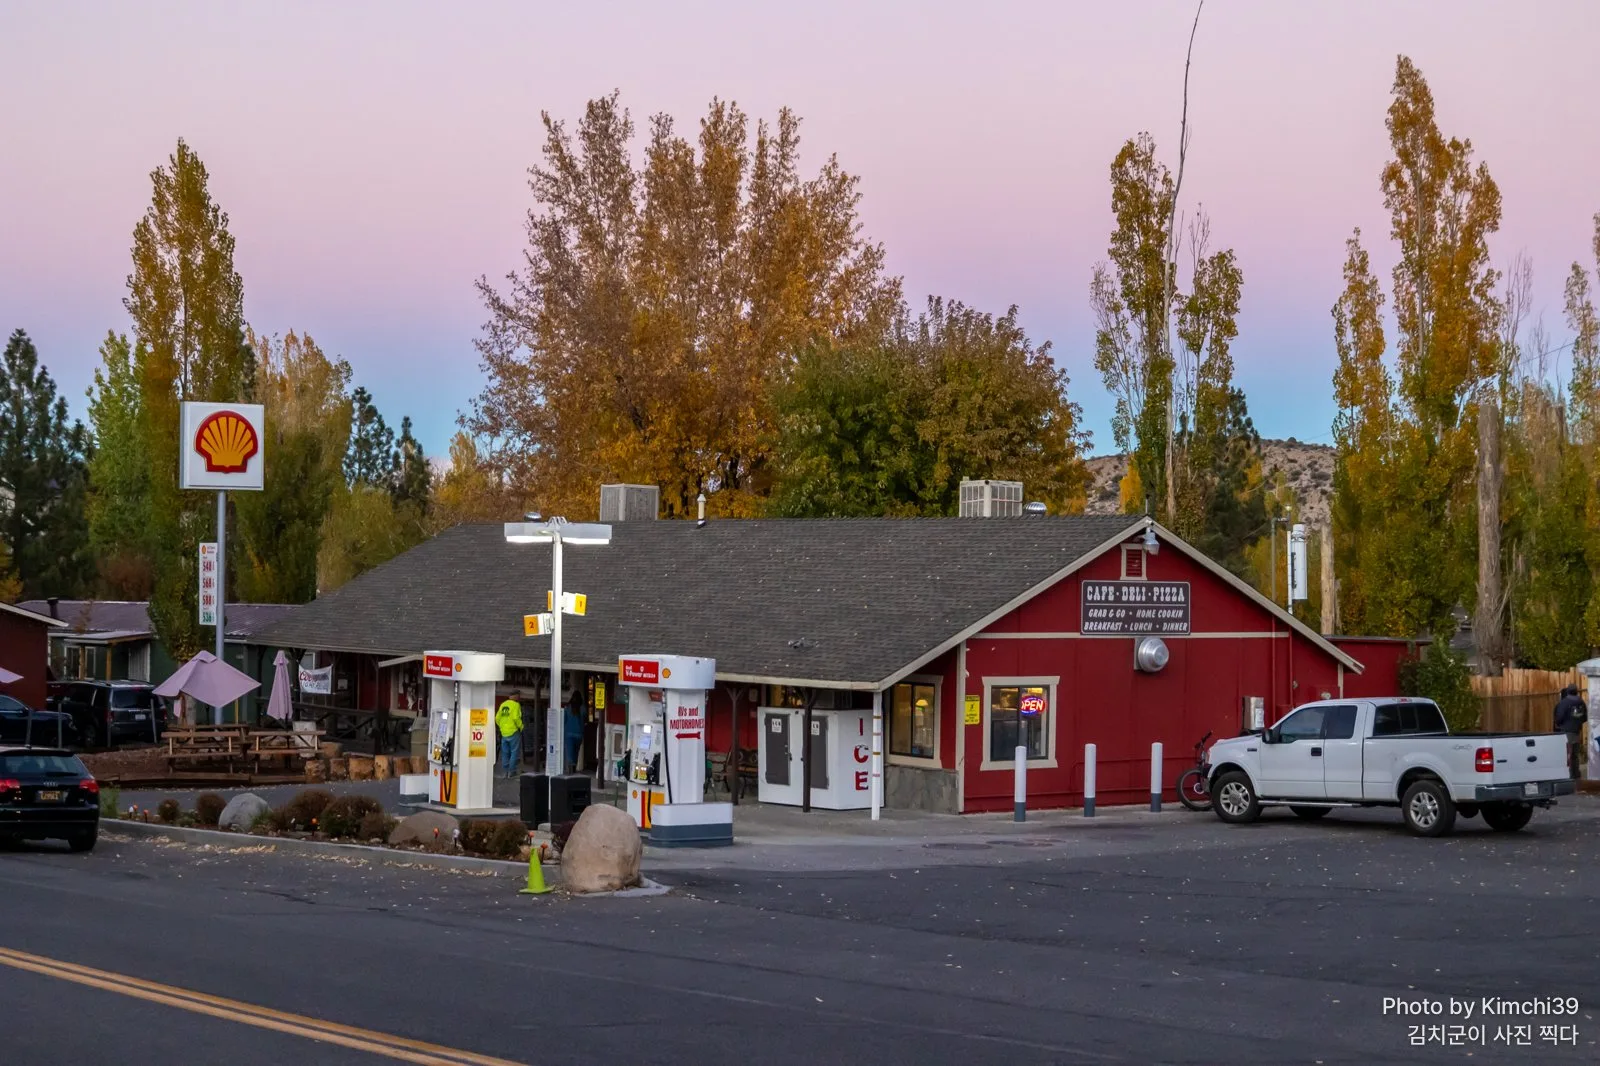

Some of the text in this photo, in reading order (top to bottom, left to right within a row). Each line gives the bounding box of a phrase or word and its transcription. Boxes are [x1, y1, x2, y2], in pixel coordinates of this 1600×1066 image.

[1086, 585, 1186, 602] CAFE DELI PIZZA
[1088, 608, 1184, 619] GRAB & GO HOME COOKIN
[528, 621, 535, 629] 2
[1084, 621, 1188, 632] BREAKFAST LUNCH DINNER
[688, 705, 699, 717] and
